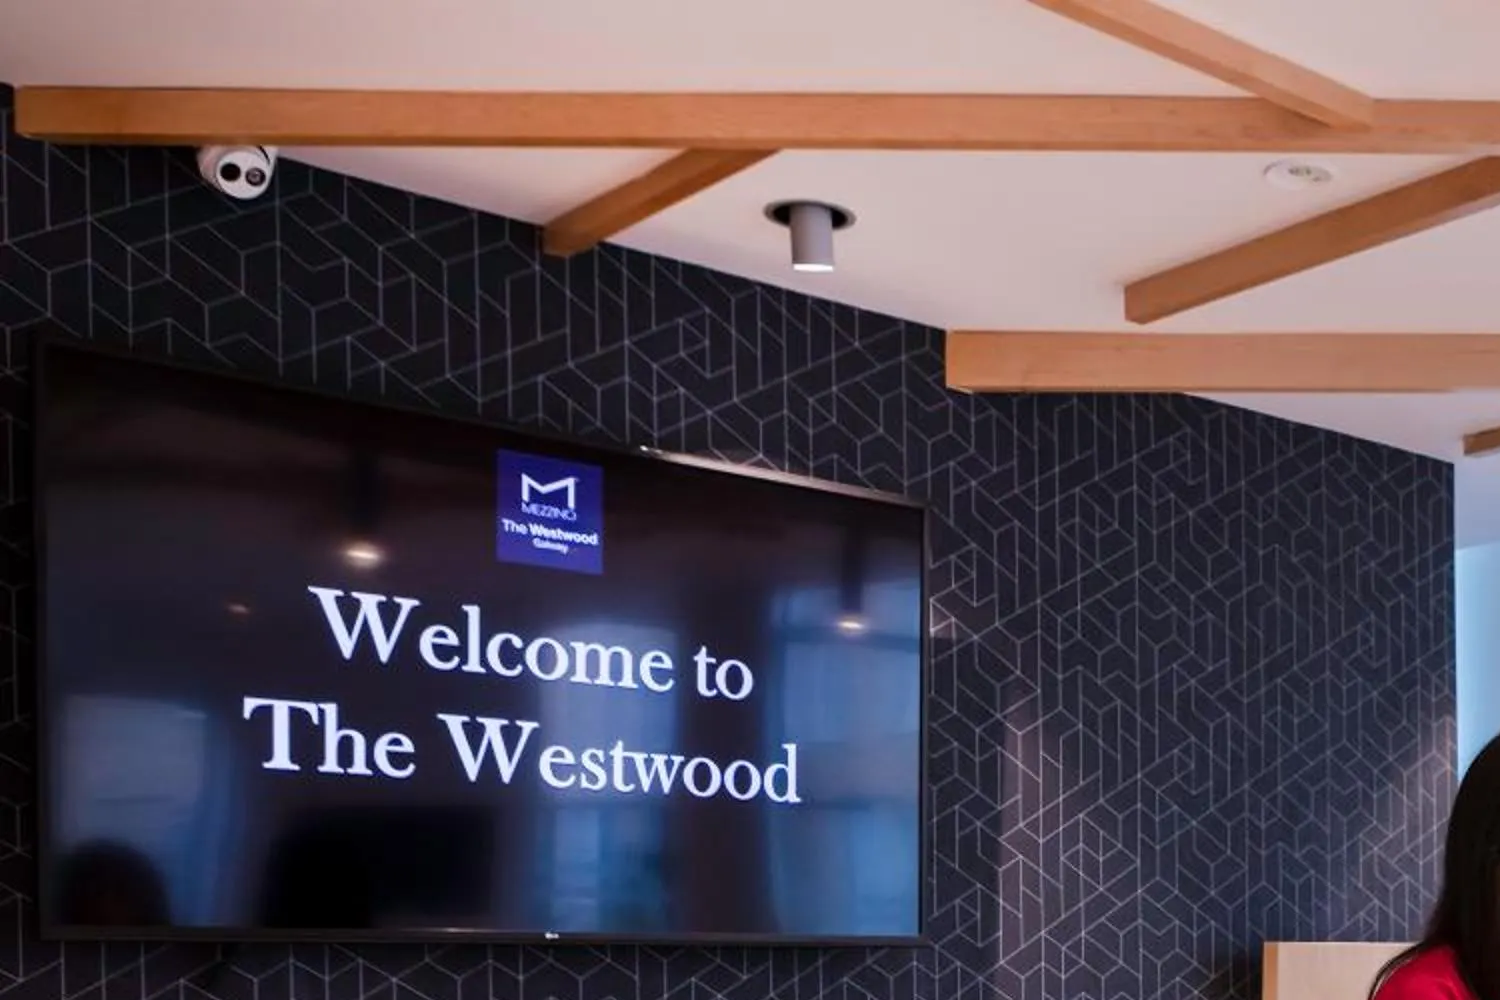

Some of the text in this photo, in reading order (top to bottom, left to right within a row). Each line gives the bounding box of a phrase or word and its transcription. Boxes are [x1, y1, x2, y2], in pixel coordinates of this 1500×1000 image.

[501, 518, 599, 546] The Westwood
[308, 586, 754, 700] Welcome to
[243, 697, 802, 804] The Westwood
